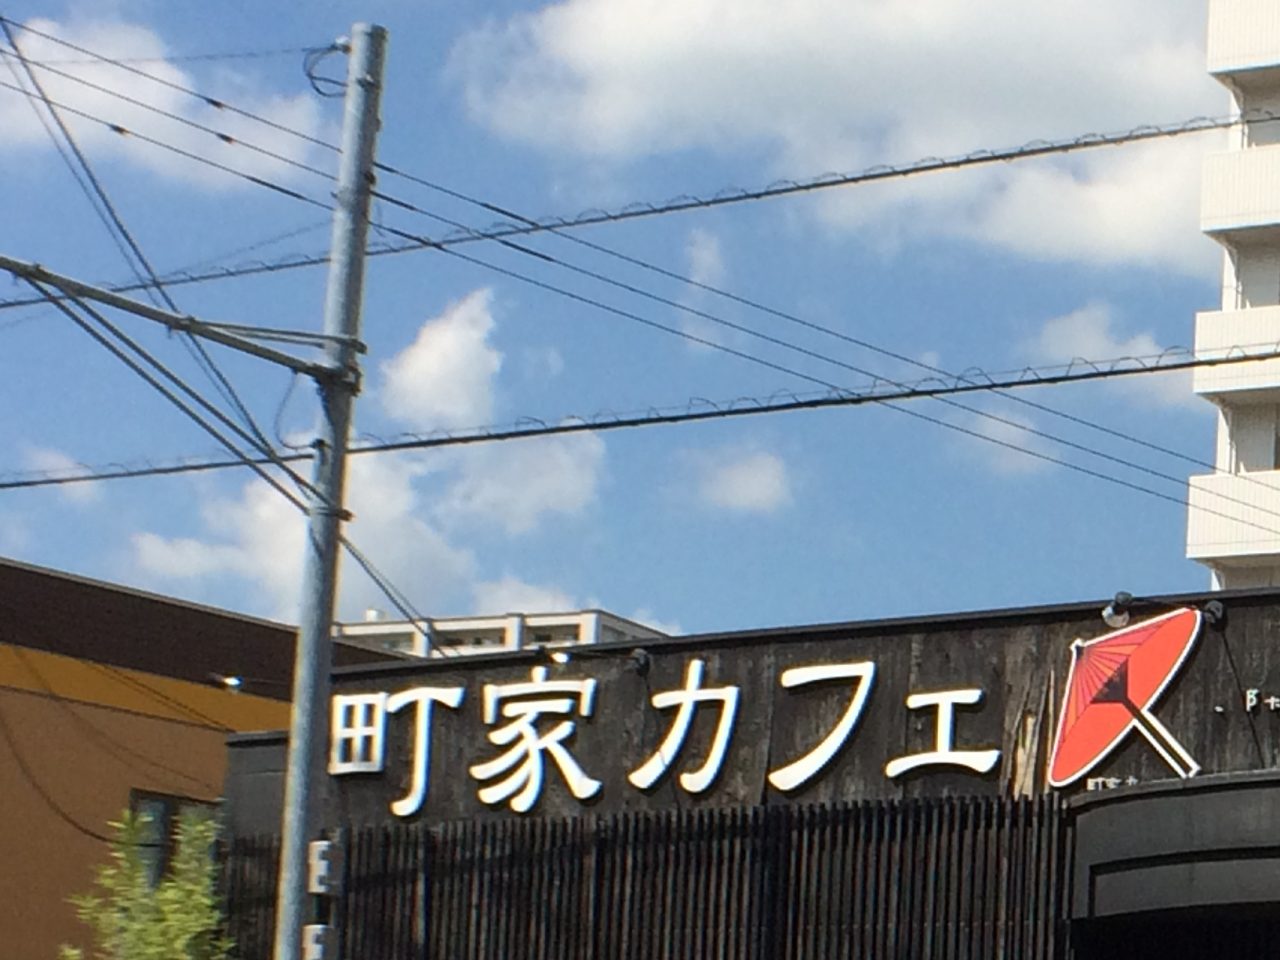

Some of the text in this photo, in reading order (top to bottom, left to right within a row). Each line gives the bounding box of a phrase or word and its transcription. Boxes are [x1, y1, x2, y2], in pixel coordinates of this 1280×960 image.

[328, 658, 1000, 817] 町家カフェ
